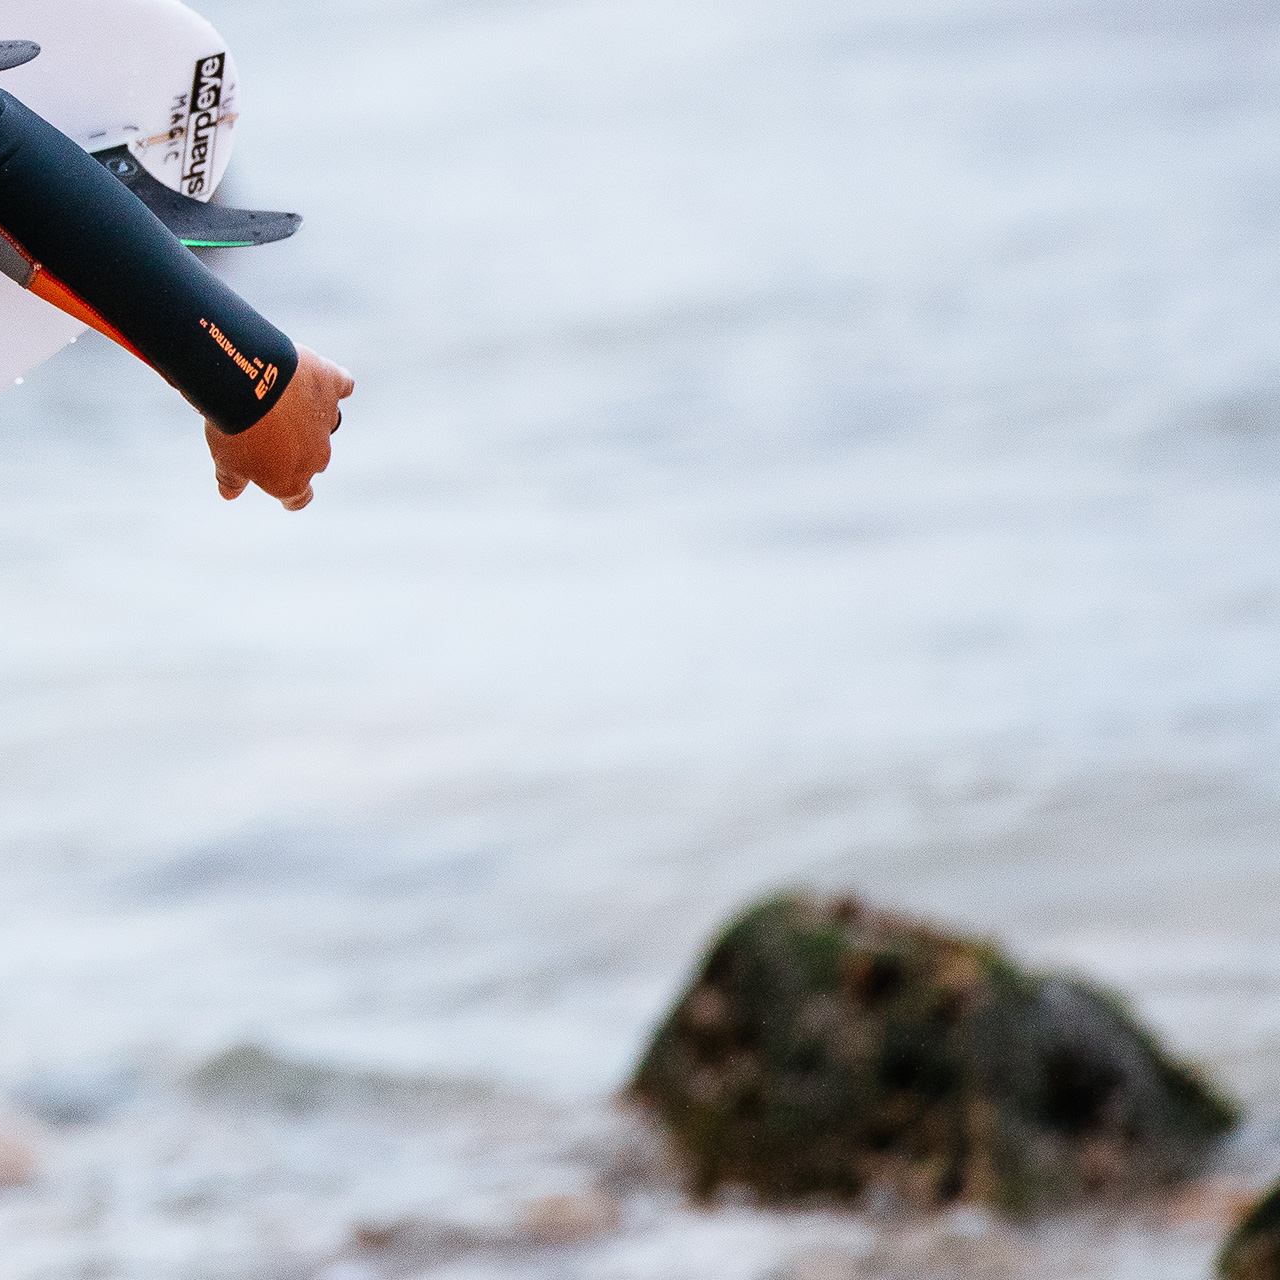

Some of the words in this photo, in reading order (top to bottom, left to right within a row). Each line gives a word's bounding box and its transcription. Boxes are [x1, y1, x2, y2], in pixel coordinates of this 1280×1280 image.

[183, 54, 223, 196] sharpeye
[208, 322, 237, 358] PATROL
[233, 352, 259, 380] DAWN
